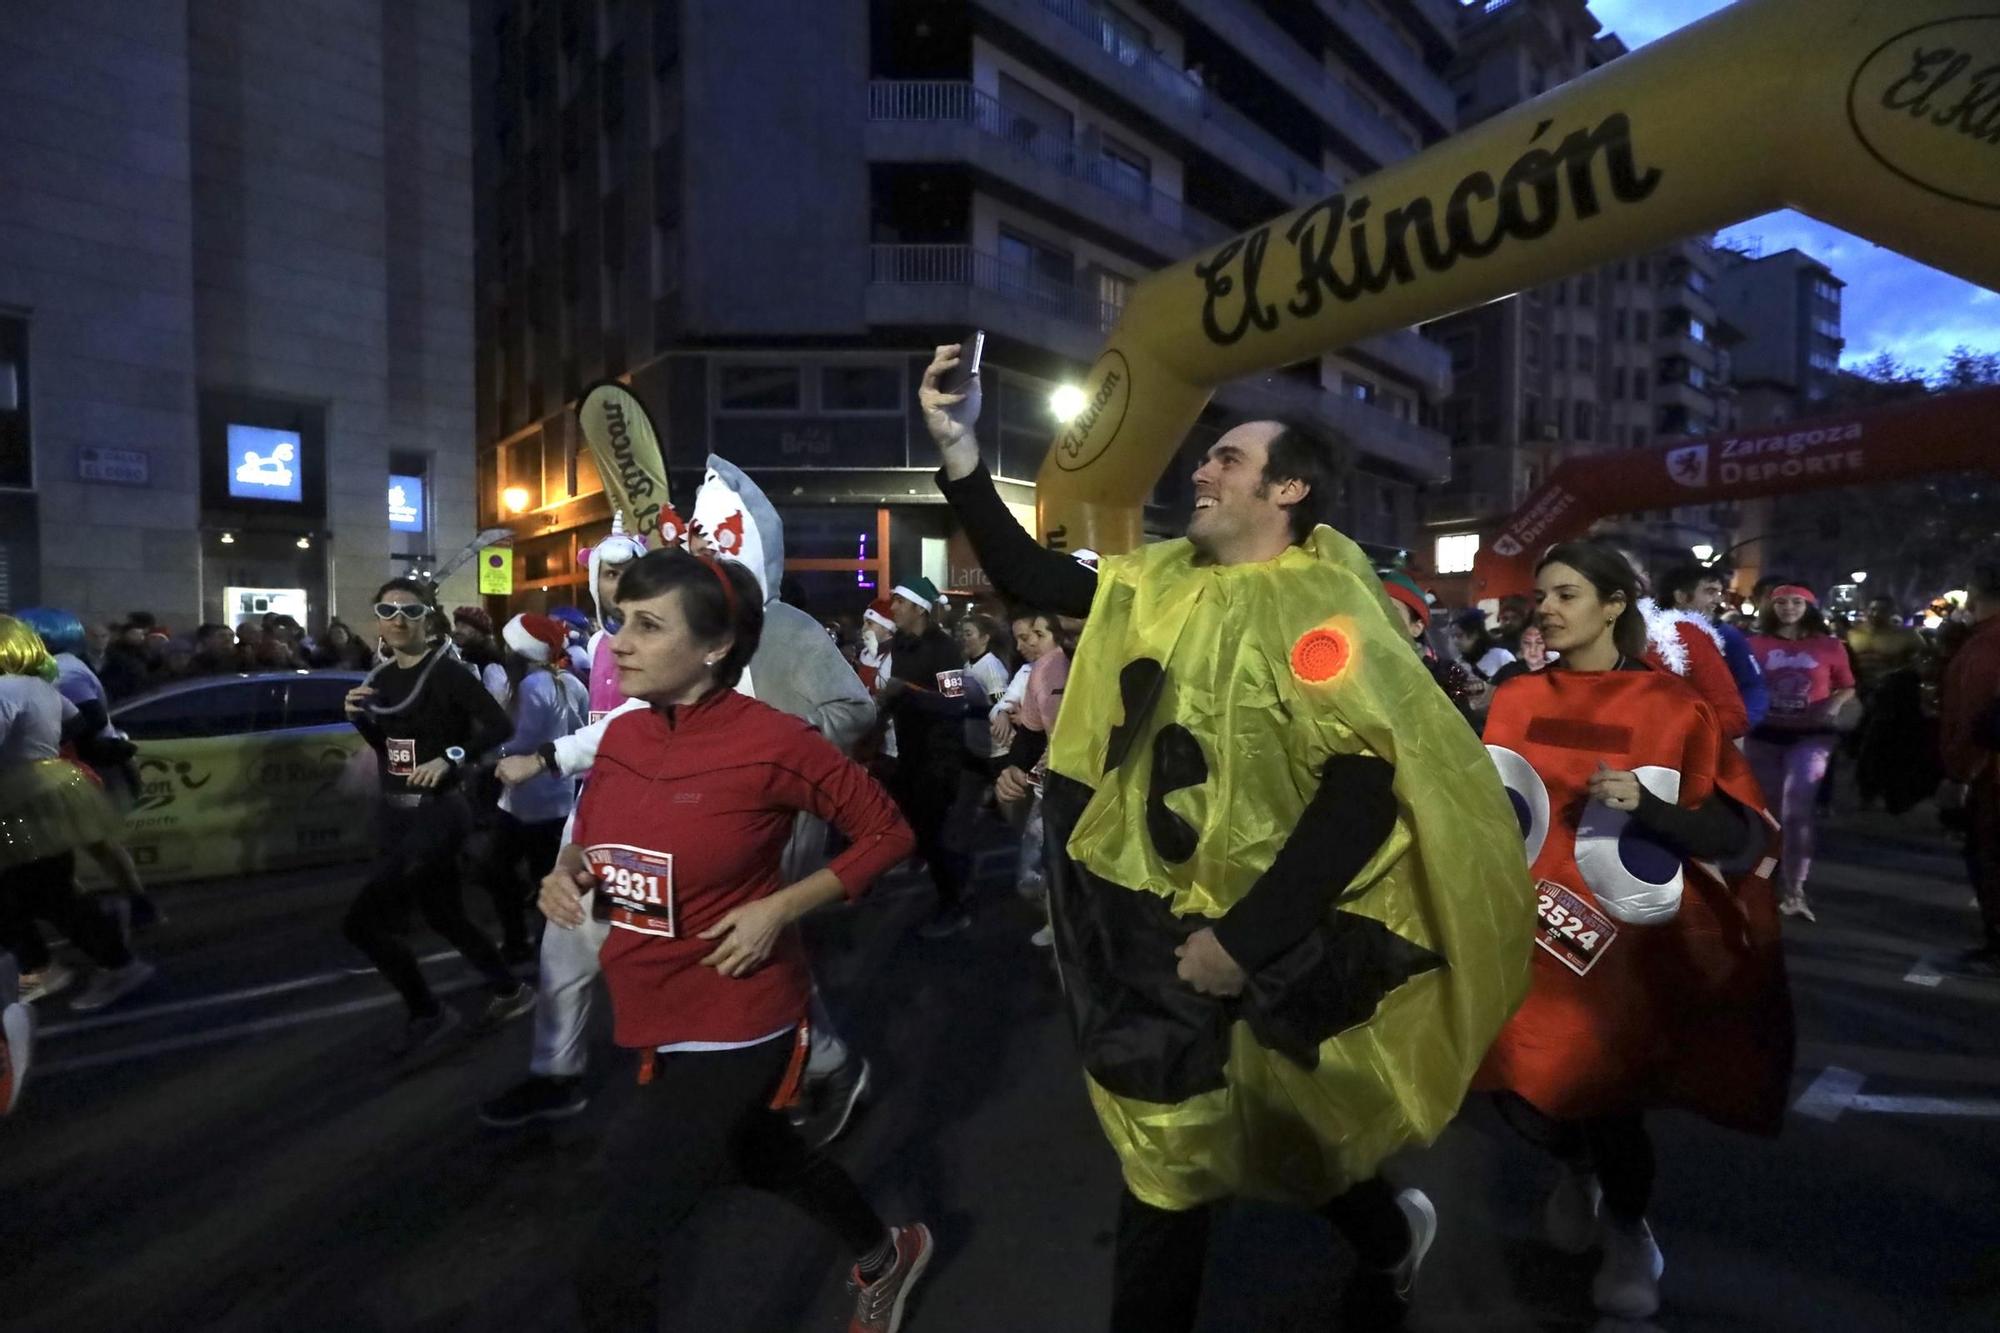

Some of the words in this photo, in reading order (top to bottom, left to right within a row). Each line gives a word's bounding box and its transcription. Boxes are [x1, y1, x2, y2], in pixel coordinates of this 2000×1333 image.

[1195, 227, 1279, 346] El
[1286, 112, 1662, 319] Rincón
[1061, 430, 1084, 459] El
[1720, 422, 1863, 459] Zaragoza
[1720, 449, 1865, 485] DEPORTE
[601, 865, 662, 905] 2931
[1538, 895, 1600, 951] 2524
